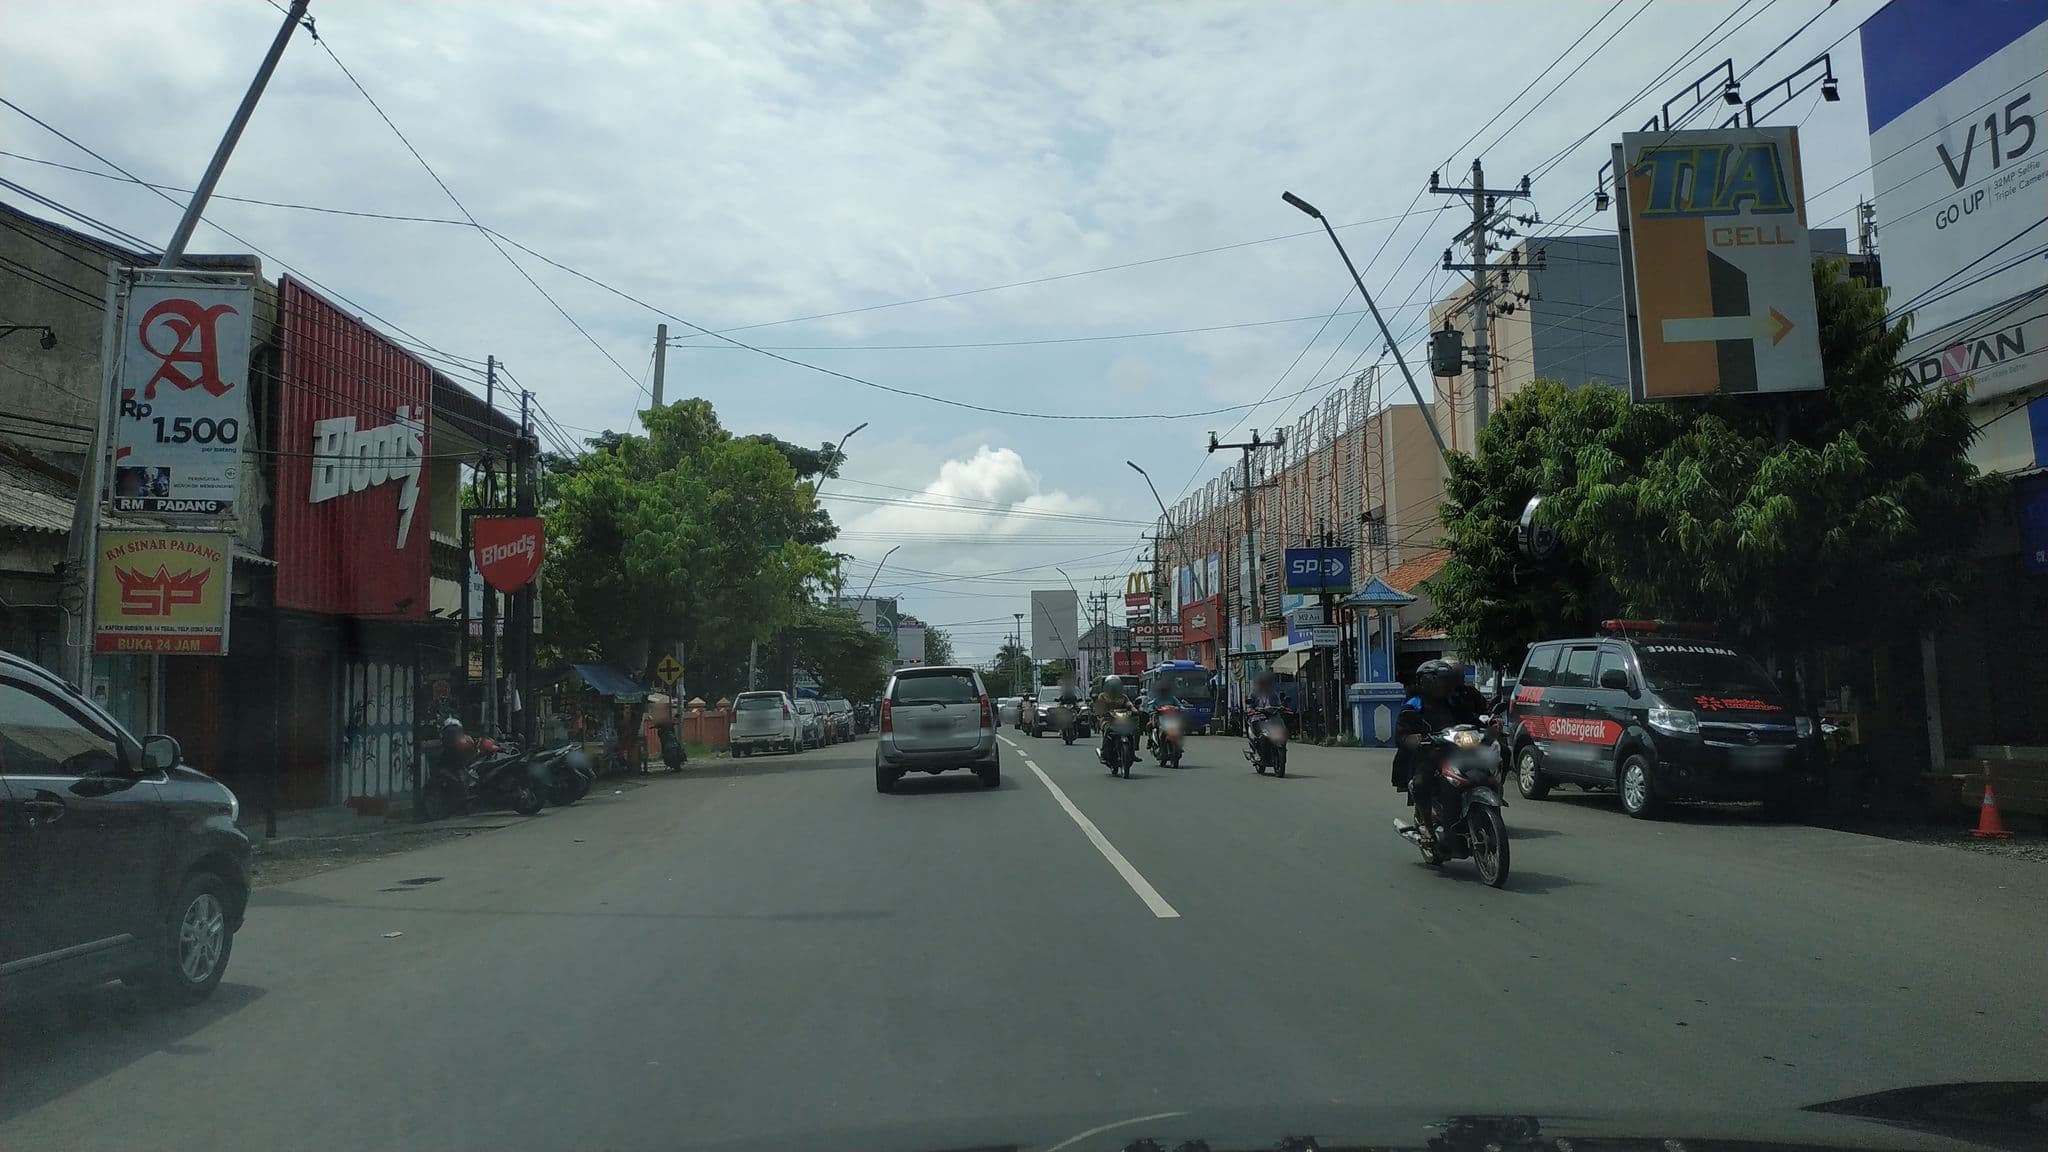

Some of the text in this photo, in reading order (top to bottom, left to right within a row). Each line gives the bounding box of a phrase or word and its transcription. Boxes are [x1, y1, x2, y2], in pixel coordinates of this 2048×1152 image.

[1936, 92, 2036, 190] V15
[1635, 143, 1795, 219] TIA
[1993, 161, 2041, 190] 32MP Selfie
[1994, 186, 2017, 201] Triple
[1935, 189, 1985, 230] GO UP
[1713, 225, 1795, 247] CELL
[1902, 327, 2026, 388] ADVAN
[120, 399, 152, 420] Rp
[152, 416, 238, 444] 1.500
[120, 499, 217, 511] RM PADANG
[105, 540, 221, 563] RM SINAR PADANG
[481, 533, 535, 567] Bloods
[117, 638, 201, 651] BUKA 24 JAM
[1549, 718, 1605, 740] @SRbergerak
